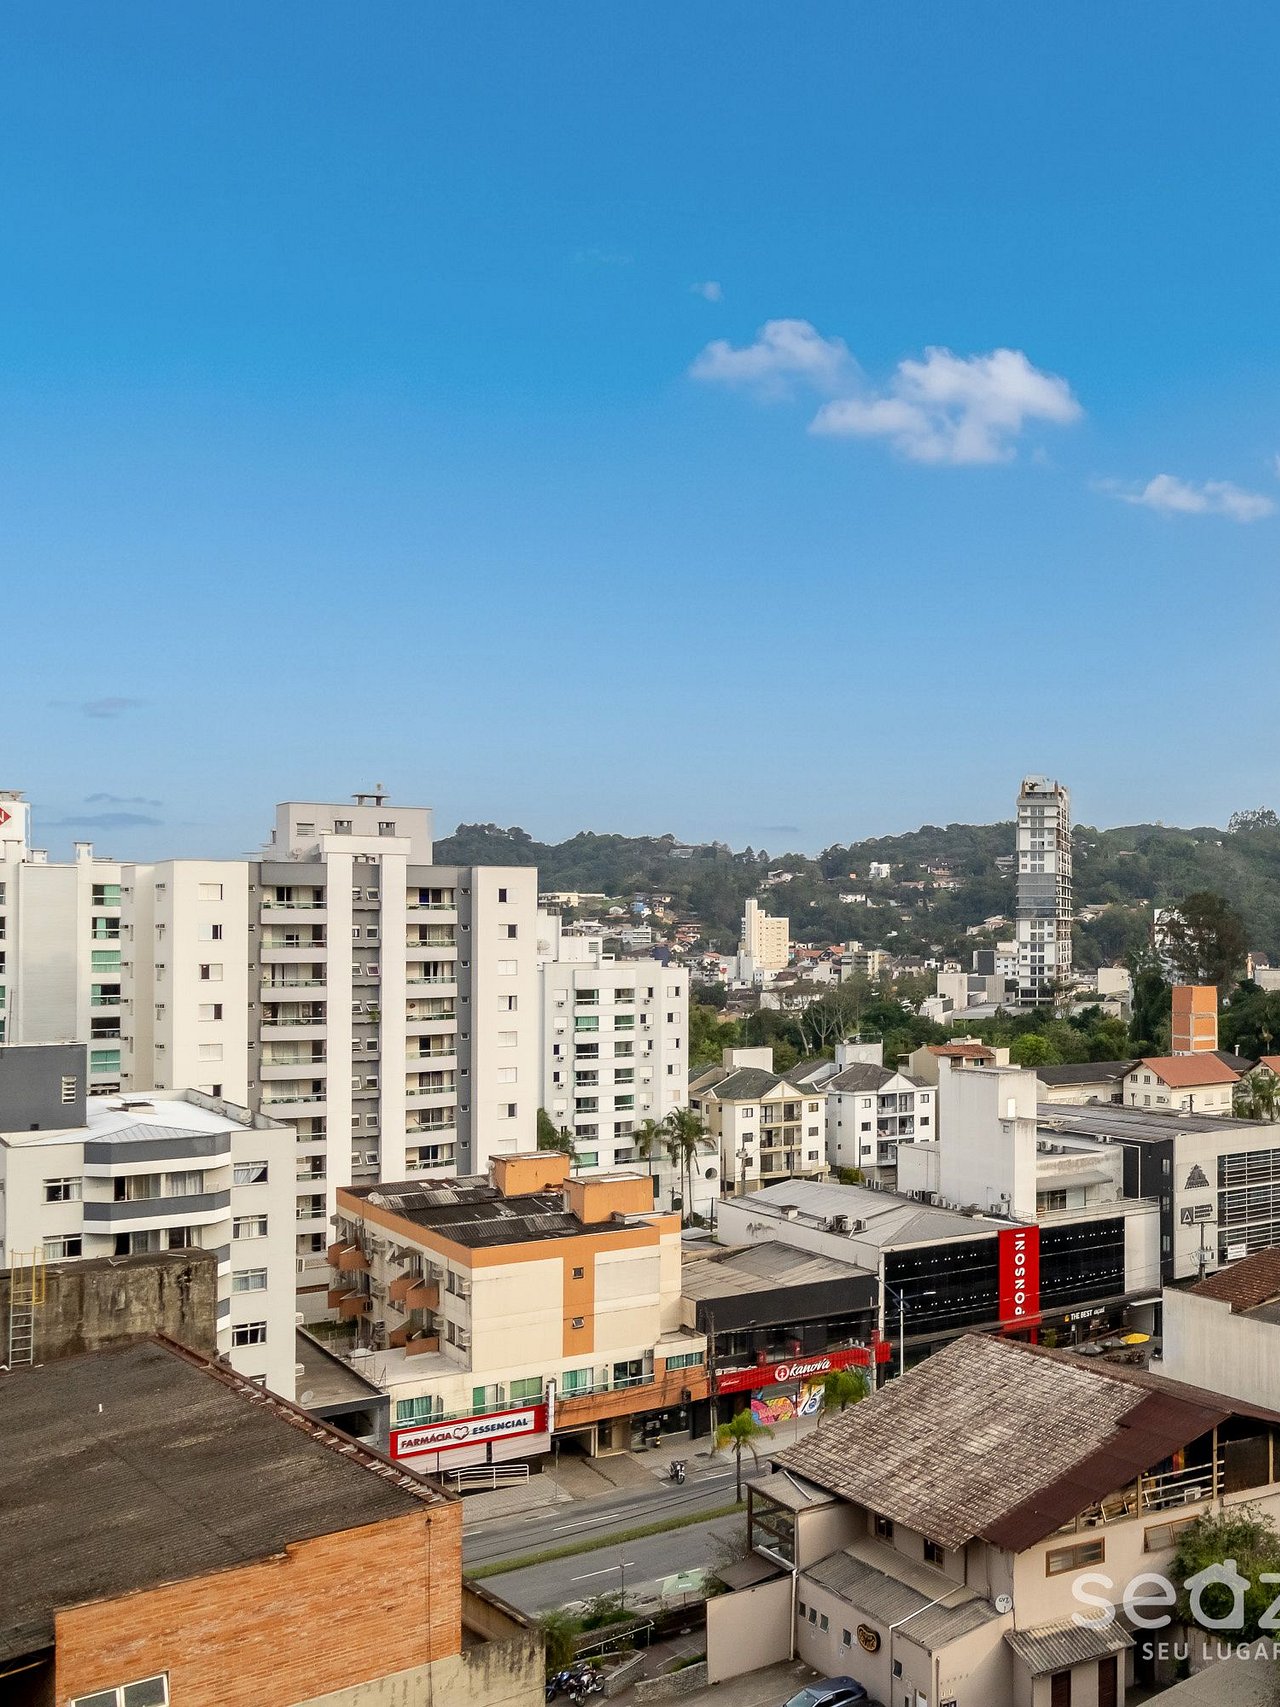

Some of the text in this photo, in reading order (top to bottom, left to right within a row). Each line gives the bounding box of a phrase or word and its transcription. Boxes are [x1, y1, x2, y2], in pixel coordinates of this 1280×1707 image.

[1014, 1233, 1026, 1316] PONSONI
[1071, 1312, 1080, 1320] THE
[1080, 1310, 1093, 1319] BEST
[401, 1417, 528, 1449] FARMÁCIA ESSENCIAL
